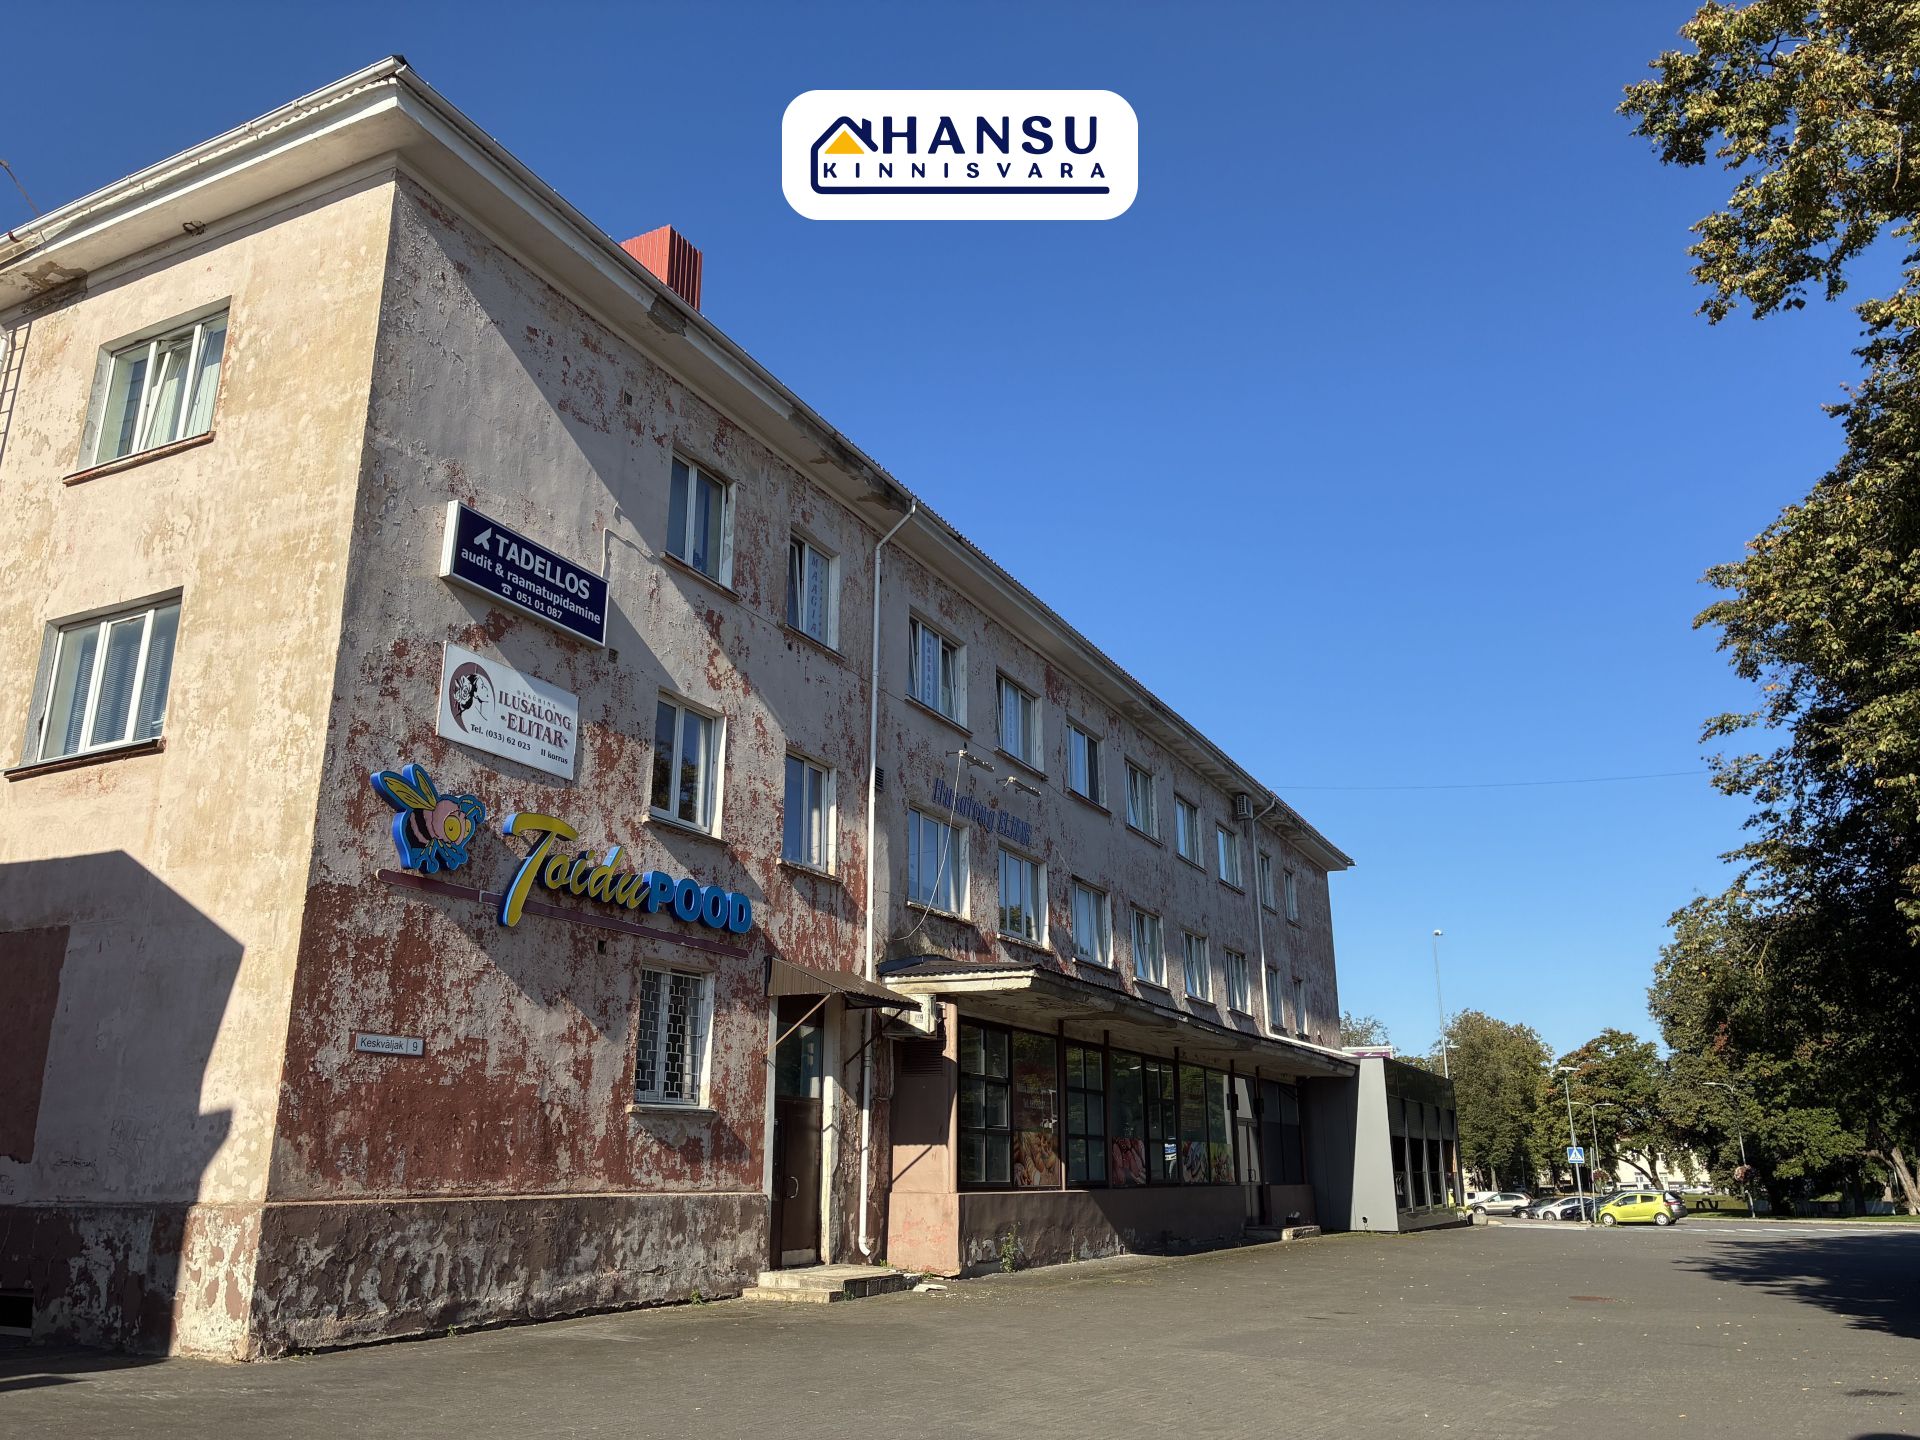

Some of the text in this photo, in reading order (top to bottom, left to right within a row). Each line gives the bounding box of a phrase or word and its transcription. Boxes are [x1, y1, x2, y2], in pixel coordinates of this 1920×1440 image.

[461, 548, 601, 625] audit & raamatupidamine
[495, 533, 590, 600] TADELLOS
[516, 590, 563, 620] 051 01 087
[498, 690, 572, 731] ILUSALONG
[470, 723, 484, 735] Tel.
[485, 728, 505, 743] (033)
[506, 736, 516, 746] 62
[517, 739, 531, 751] 023
[547, 748, 568, 765] korrus
[360, 1036, 418, 1052] Keskväljak 9
